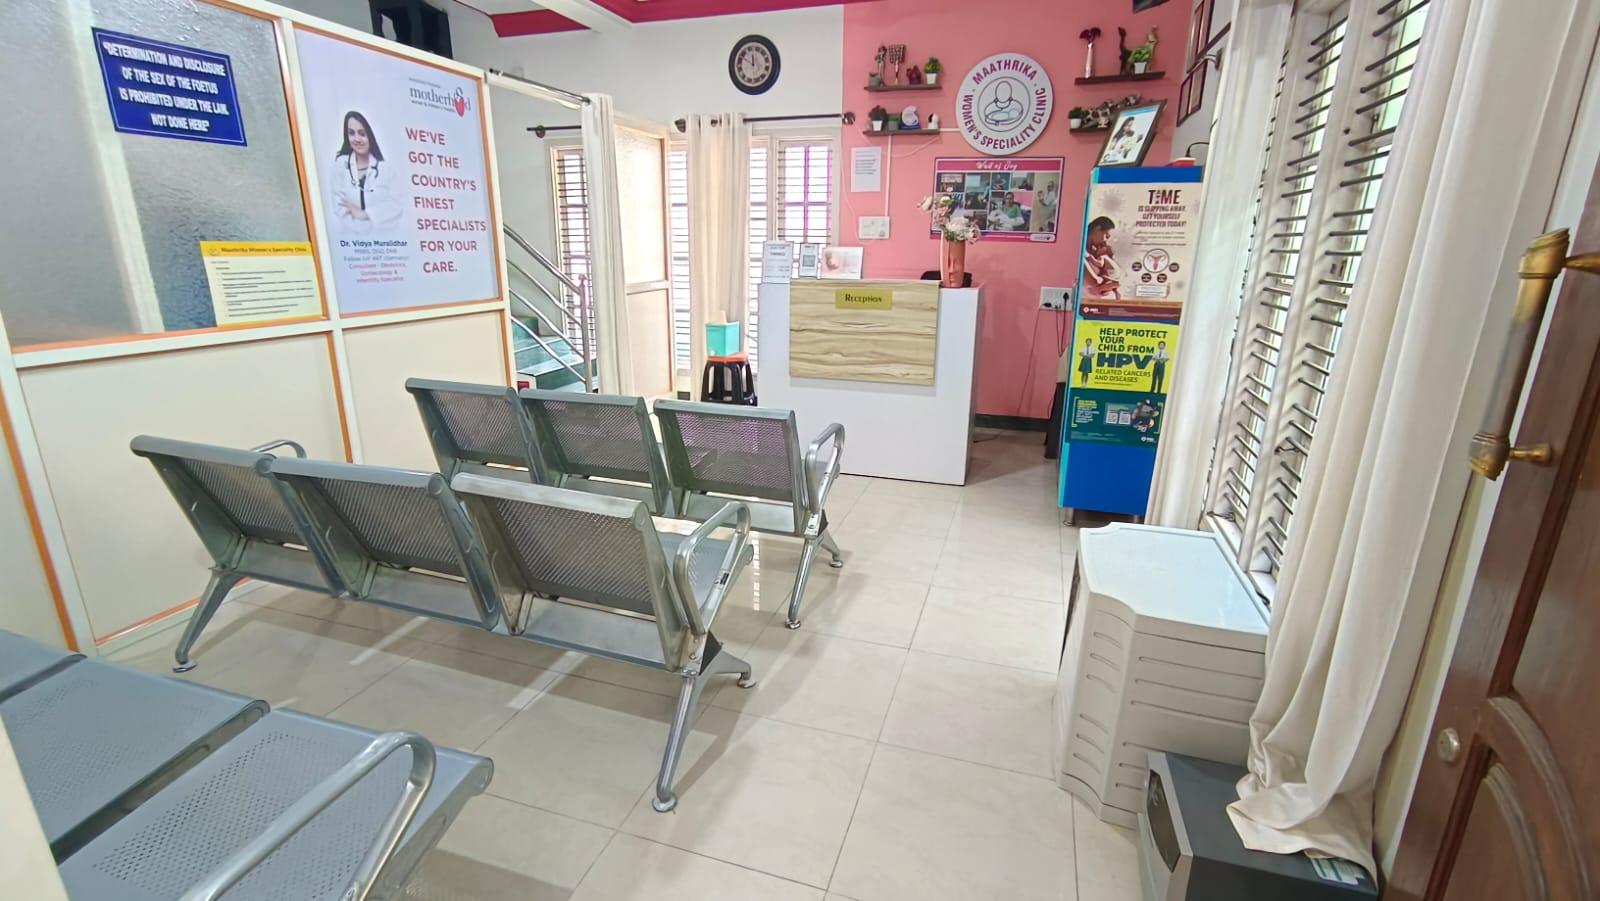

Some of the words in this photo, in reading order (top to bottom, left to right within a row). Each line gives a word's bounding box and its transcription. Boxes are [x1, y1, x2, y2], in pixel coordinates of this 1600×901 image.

[168, 54, 183, 68] AND
[183, 56, 226, 76] DISCLOSURE
[972, 59, 1038, 85] MAATHRIKA
[122, 66, 134, 80] OF
[134, 68, 150, 83] THE
[150, 70, 166, 85] SEX
[166, 74, 177, 87] OF
[177, 75, 192, 90] THE
[192, 77, 218, 94] FOETUS
[118, 87, 130, 101] IS
[130, 89, 173, 107] PROHIBITED
[173, 95, 198, 111] UNDER
[198, 100, 213, 113] THE
[410, 86, 471, 111] motherhd
[150, 112, 168, 127] NOT
[168, 115, 189, 130] DONE
[962, 94, 982, 140] WOMEN'S
[980, 124, 1036, 150] SPECIALITY
[1032, 87, 1047, 124] CLINIC
[405, 127, 446, 146] WE'VE
[408, 151, 433, 165] GOT
[437, 154, 460, 169] THE
[411, 173, 477, 191] COUNTRY'S
[413, 196, 455, 210] FINEST
[416, 218, 487, 231] SPECIALISTS
[352, 240, 372, 248] Vidya
[420, 240, 445, 252] FOR
[448, 240, 477, 251] YOUR
[423, 261, 458, 273] CARE.
[1099, 327, 1124, 336] HELP
[1125, 328, 1168, 339] PROTECT
[1099, 335, 1125, 344] YOUR
[1098, 343, 1125, 352] CHILD
[1127, 344, 1154, 354] FROM
[1096, 352, 1154, 369] HPV
